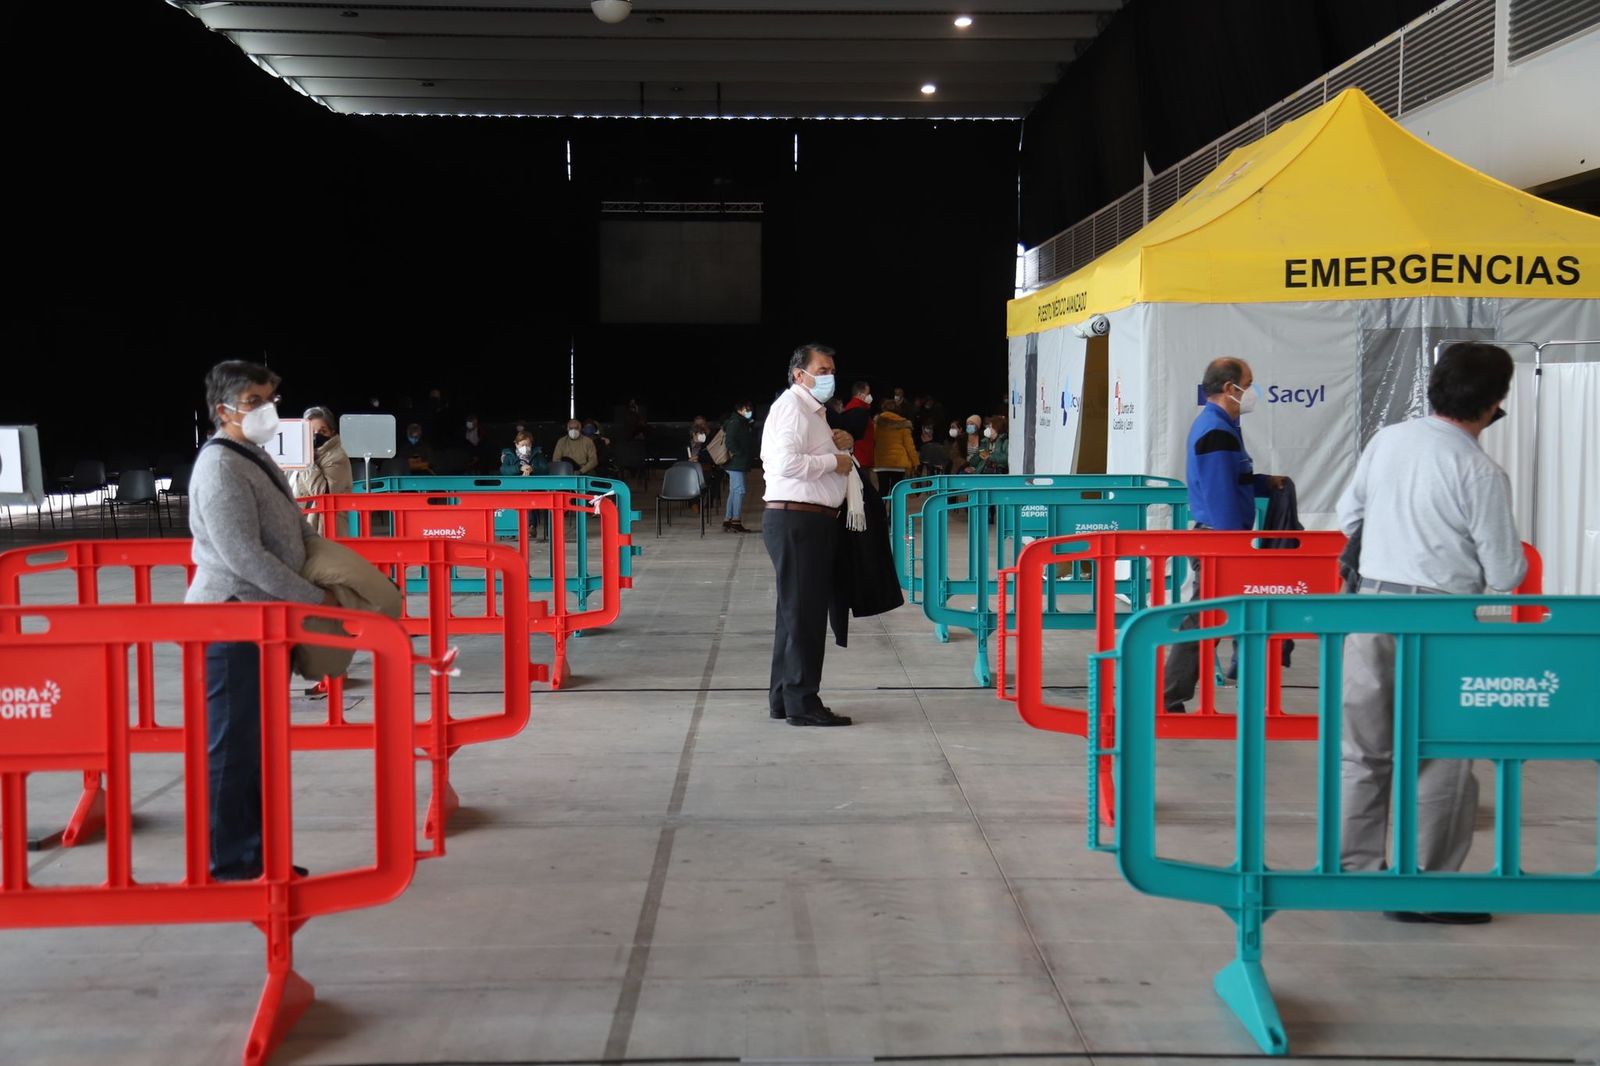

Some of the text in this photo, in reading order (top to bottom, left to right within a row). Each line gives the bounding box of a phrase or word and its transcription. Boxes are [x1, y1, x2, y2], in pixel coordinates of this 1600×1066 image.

[1284, 253, 1580, 289] EMERGENCIAS
[1267, 385, 1325, 408] Sacyl
[277, 432, 286, 456] 1
[0, 703, 52, 719] ORTE
[1460, 693, 1550, 708] DEPORTE
